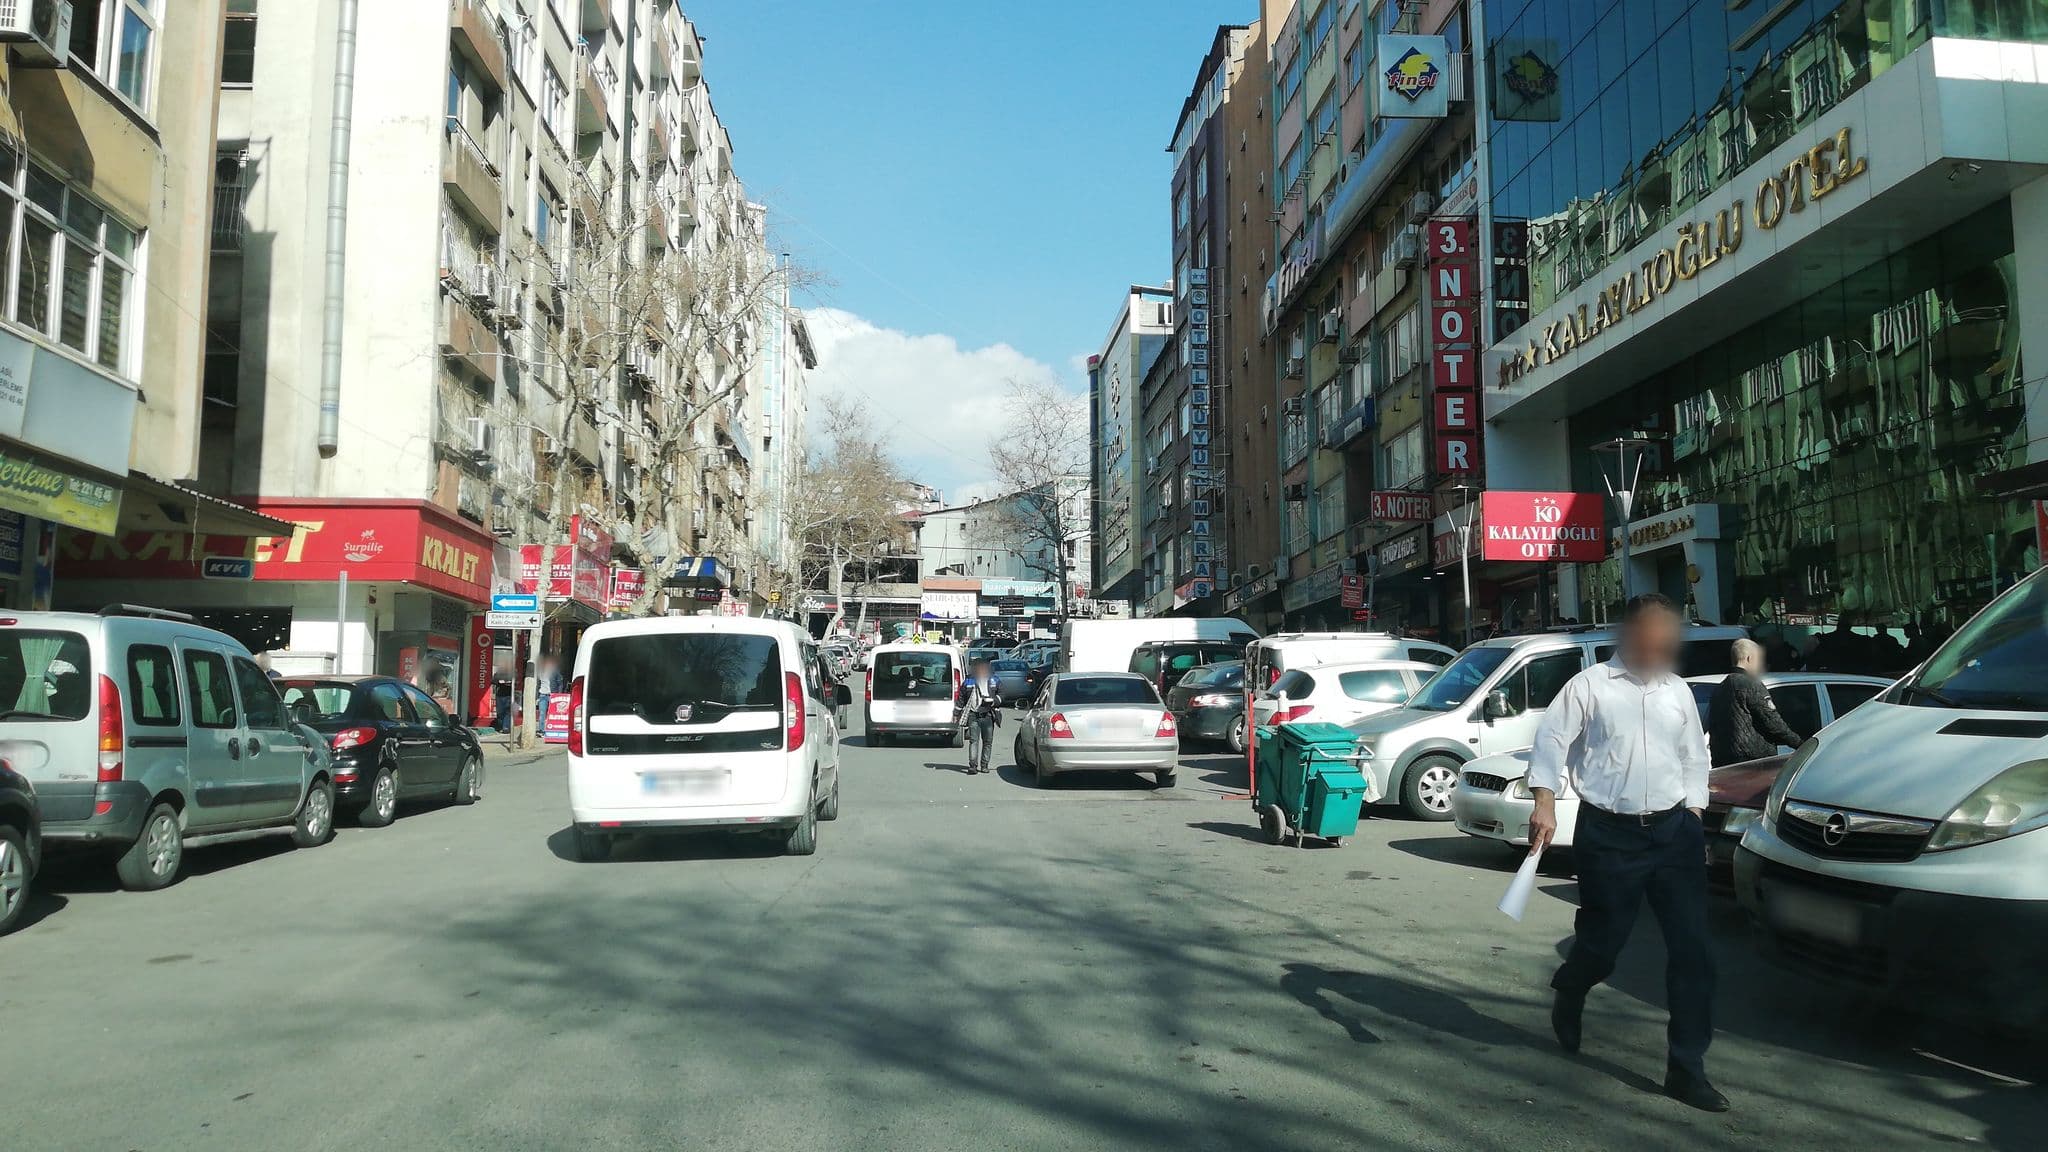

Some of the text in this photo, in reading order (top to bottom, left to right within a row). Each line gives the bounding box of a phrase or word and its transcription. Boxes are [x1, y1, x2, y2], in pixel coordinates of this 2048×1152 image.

[1389, 72, 1438, 88] final
[1753, 127, 1867, 230] OTEL
[1439, 226, 1465, 254] 3.
[1439, 269, 1469, 469] NOTER
[1373, 496, 1432, 519] 3. NOTER
[1488, 523, 1601, 541] KALAYLIOĞLU
[343, 541, 384, 554] Surpiliç
[1521, 543, 1569, 558] OTEL
[209, 563, 245, 574] KVK
[421, 536, 480, 583] KRAL ET
[479, 649, 488, 689] vodafone
